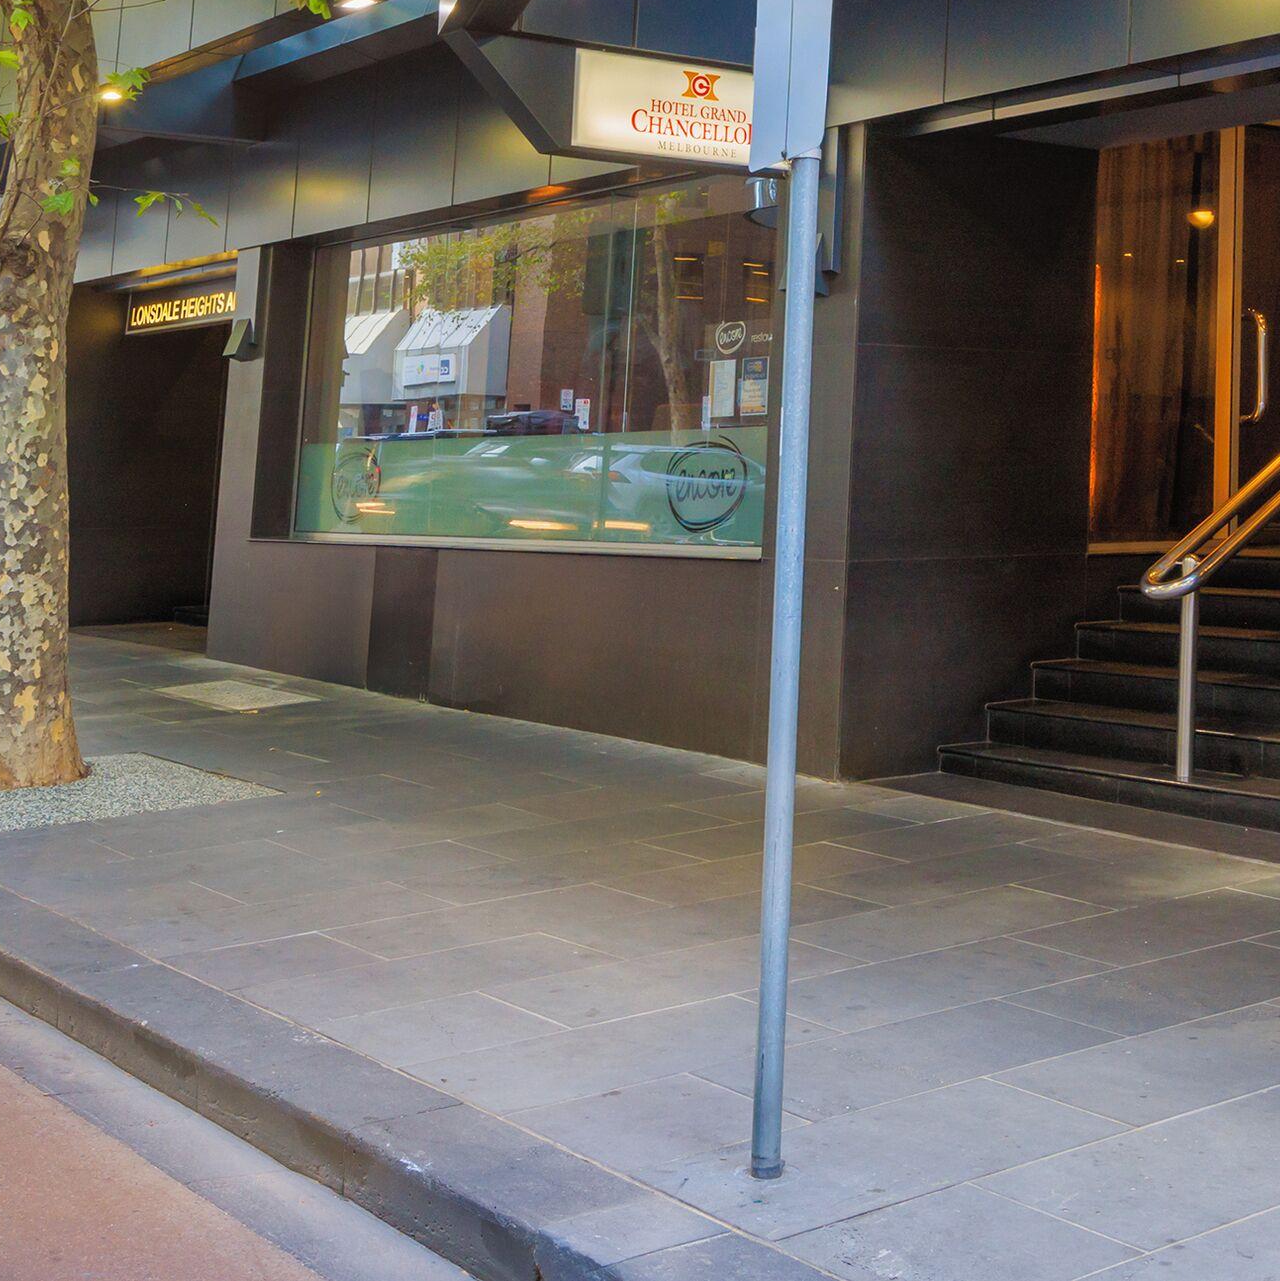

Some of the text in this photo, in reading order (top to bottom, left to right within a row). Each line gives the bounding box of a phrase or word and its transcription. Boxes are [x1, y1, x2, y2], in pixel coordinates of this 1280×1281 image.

[650, 99, 747, 124] HOTEL GRAND
[657, 140, 737, 158] MELBOURNE
[131, 300, 181, 326] LONSDALE
[181, 292, 225, 319] HEIGHTS
[675, 467, 738, 503] encore
